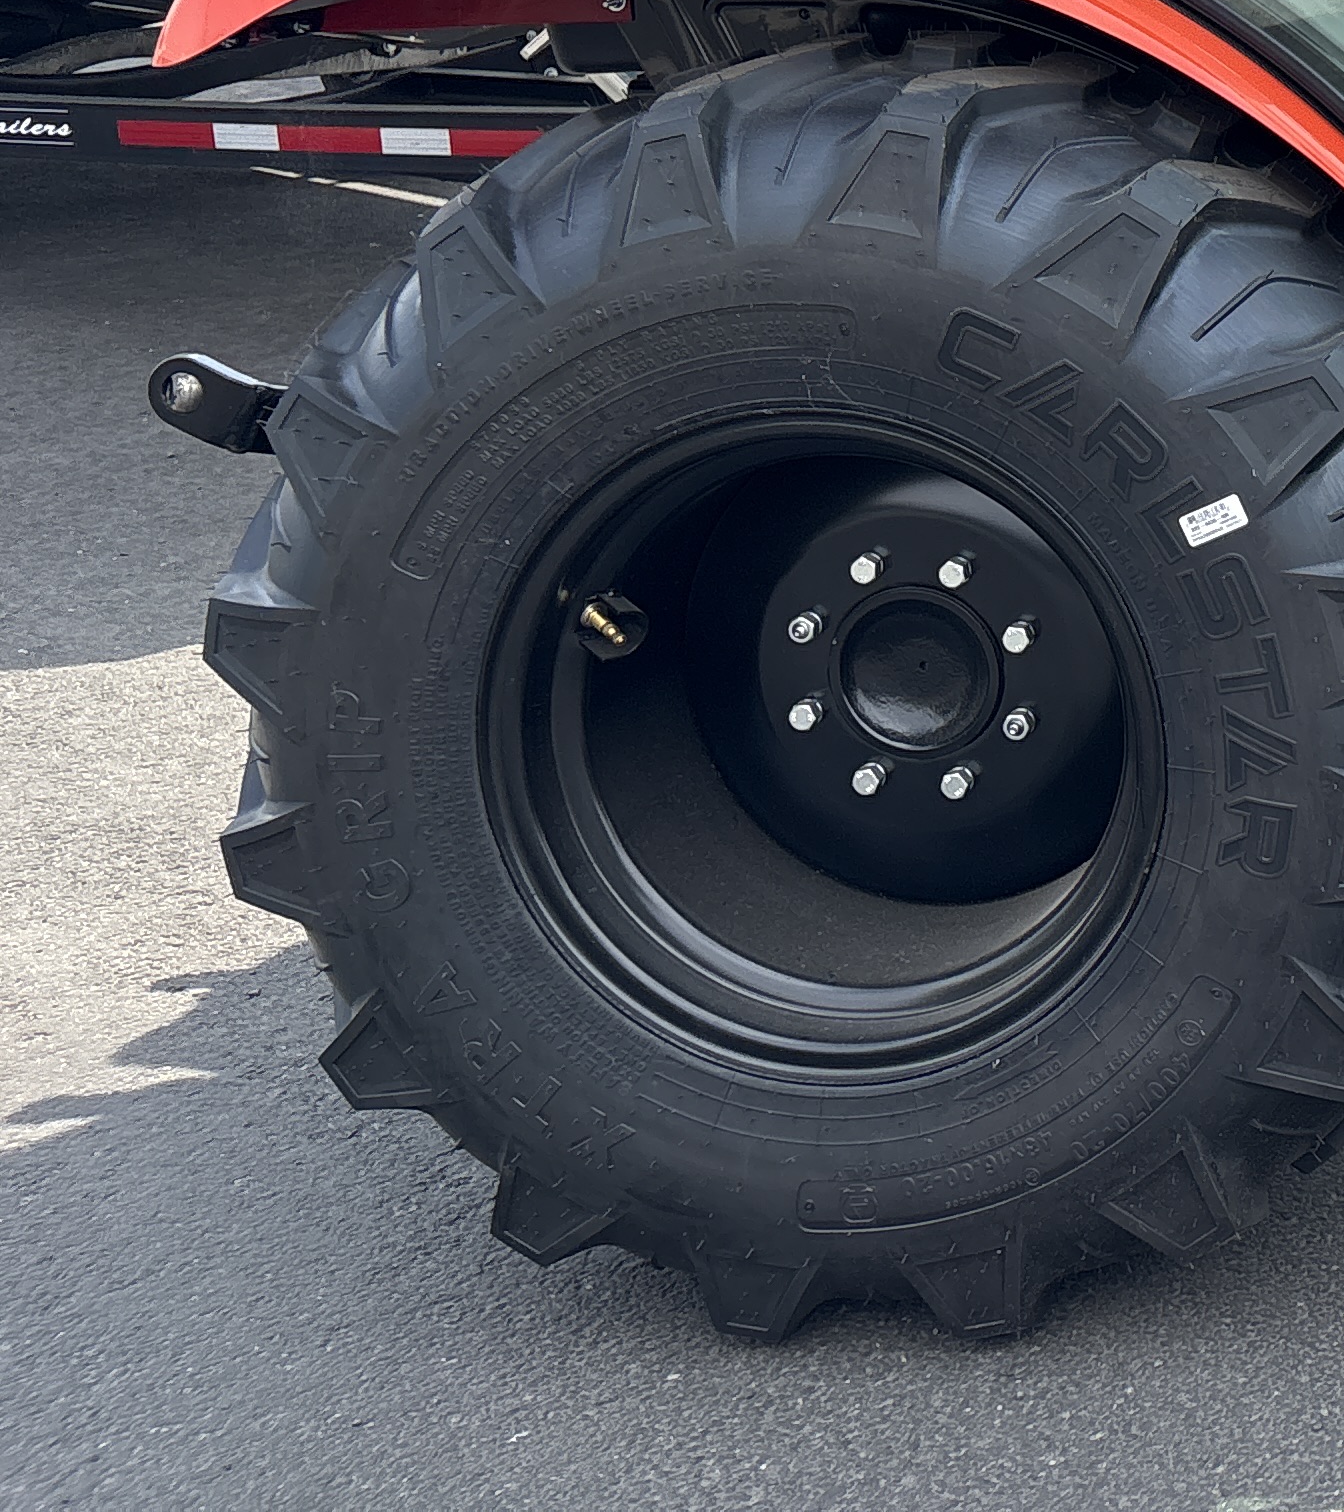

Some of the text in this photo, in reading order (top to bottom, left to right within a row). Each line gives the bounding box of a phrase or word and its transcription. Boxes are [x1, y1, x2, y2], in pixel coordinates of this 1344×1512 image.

[937, 307, 1297, 879] CARLSTAR
[325, 677, 419, 924] GRIP
[401, 956, 639, 1179] XTRA
[1066, 1046, 1198, 1164] 400/70-20
